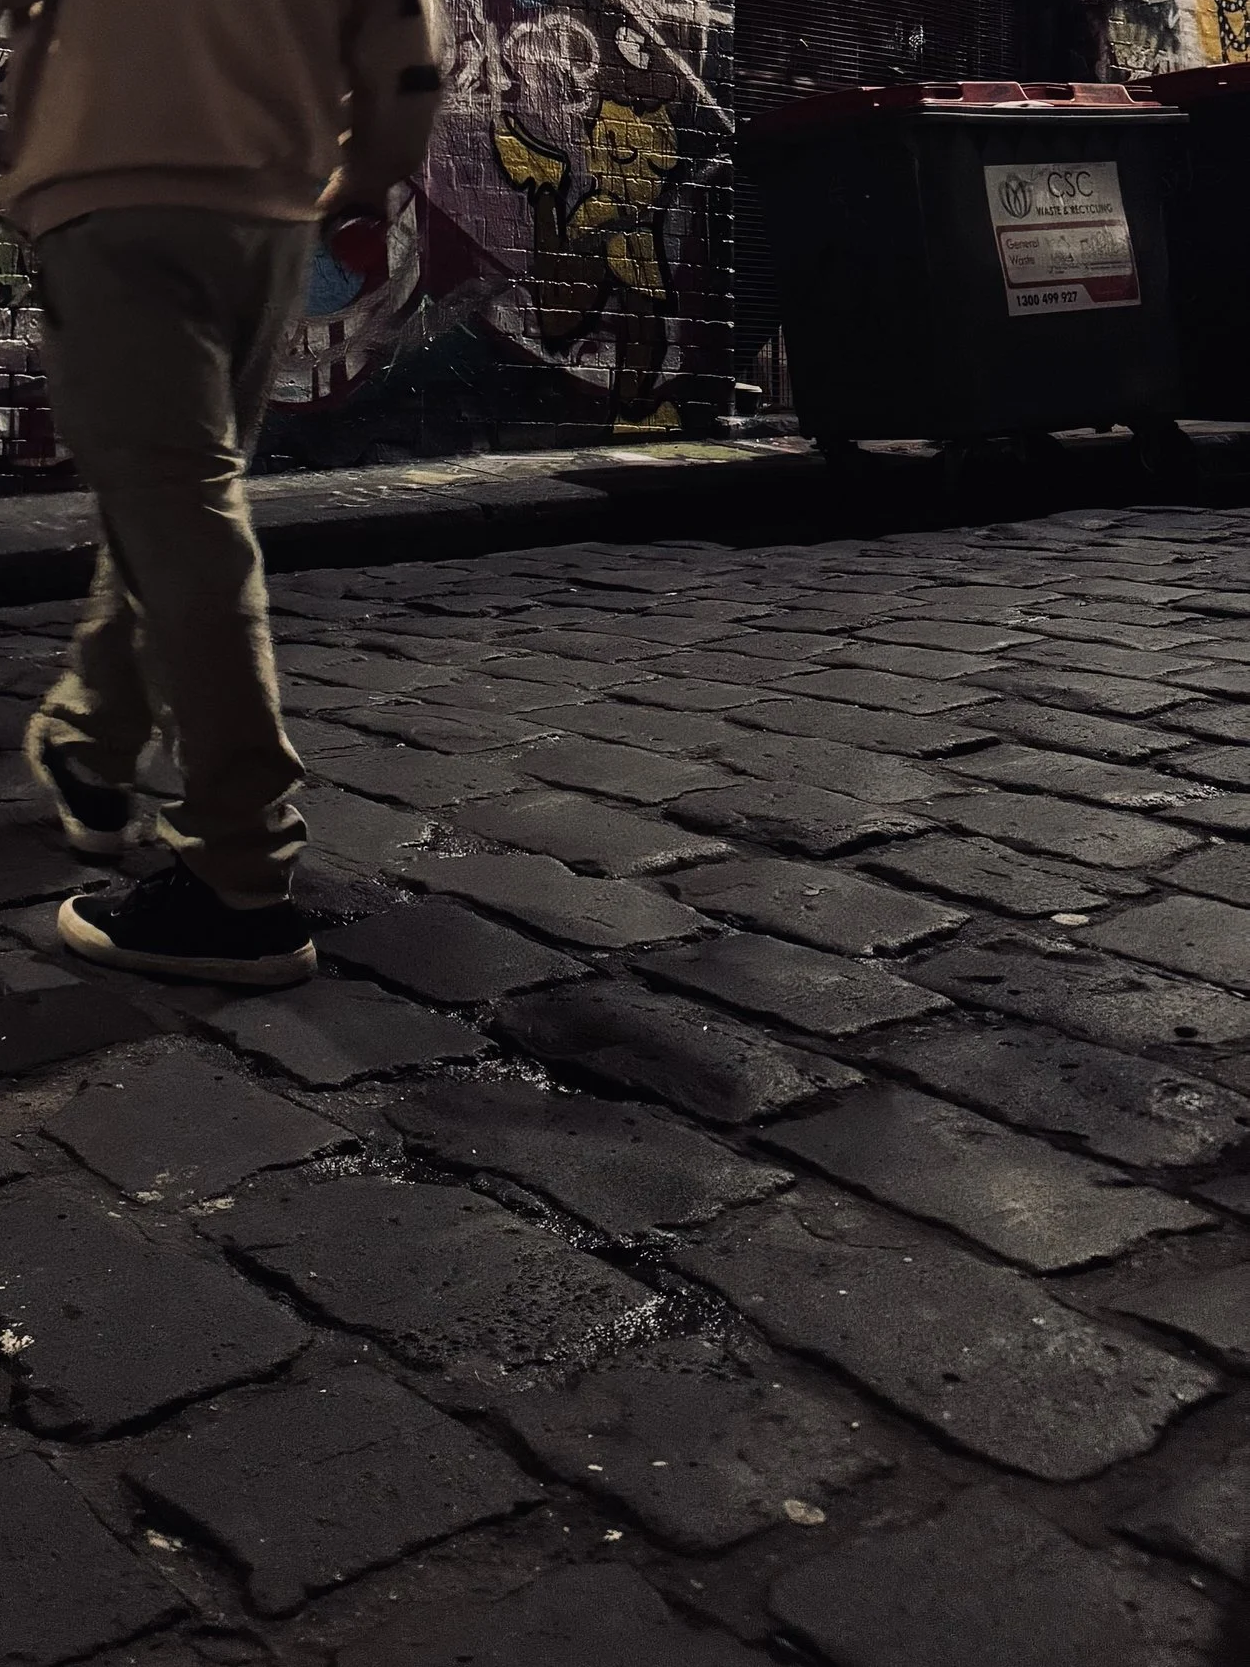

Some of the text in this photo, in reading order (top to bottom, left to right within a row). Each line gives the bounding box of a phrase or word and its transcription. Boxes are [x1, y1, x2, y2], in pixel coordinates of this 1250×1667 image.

[1047, 170, 1094, 198] CSC
[1035, 205, 1062, 216] WASTE
[1069, 202, 1114, 215] RECYCLING
[1006, 237, 1040, 250] General
[1008, 254, 1036, 266] Waste
[1016, 290, 1078, 307] 1300 499 927
